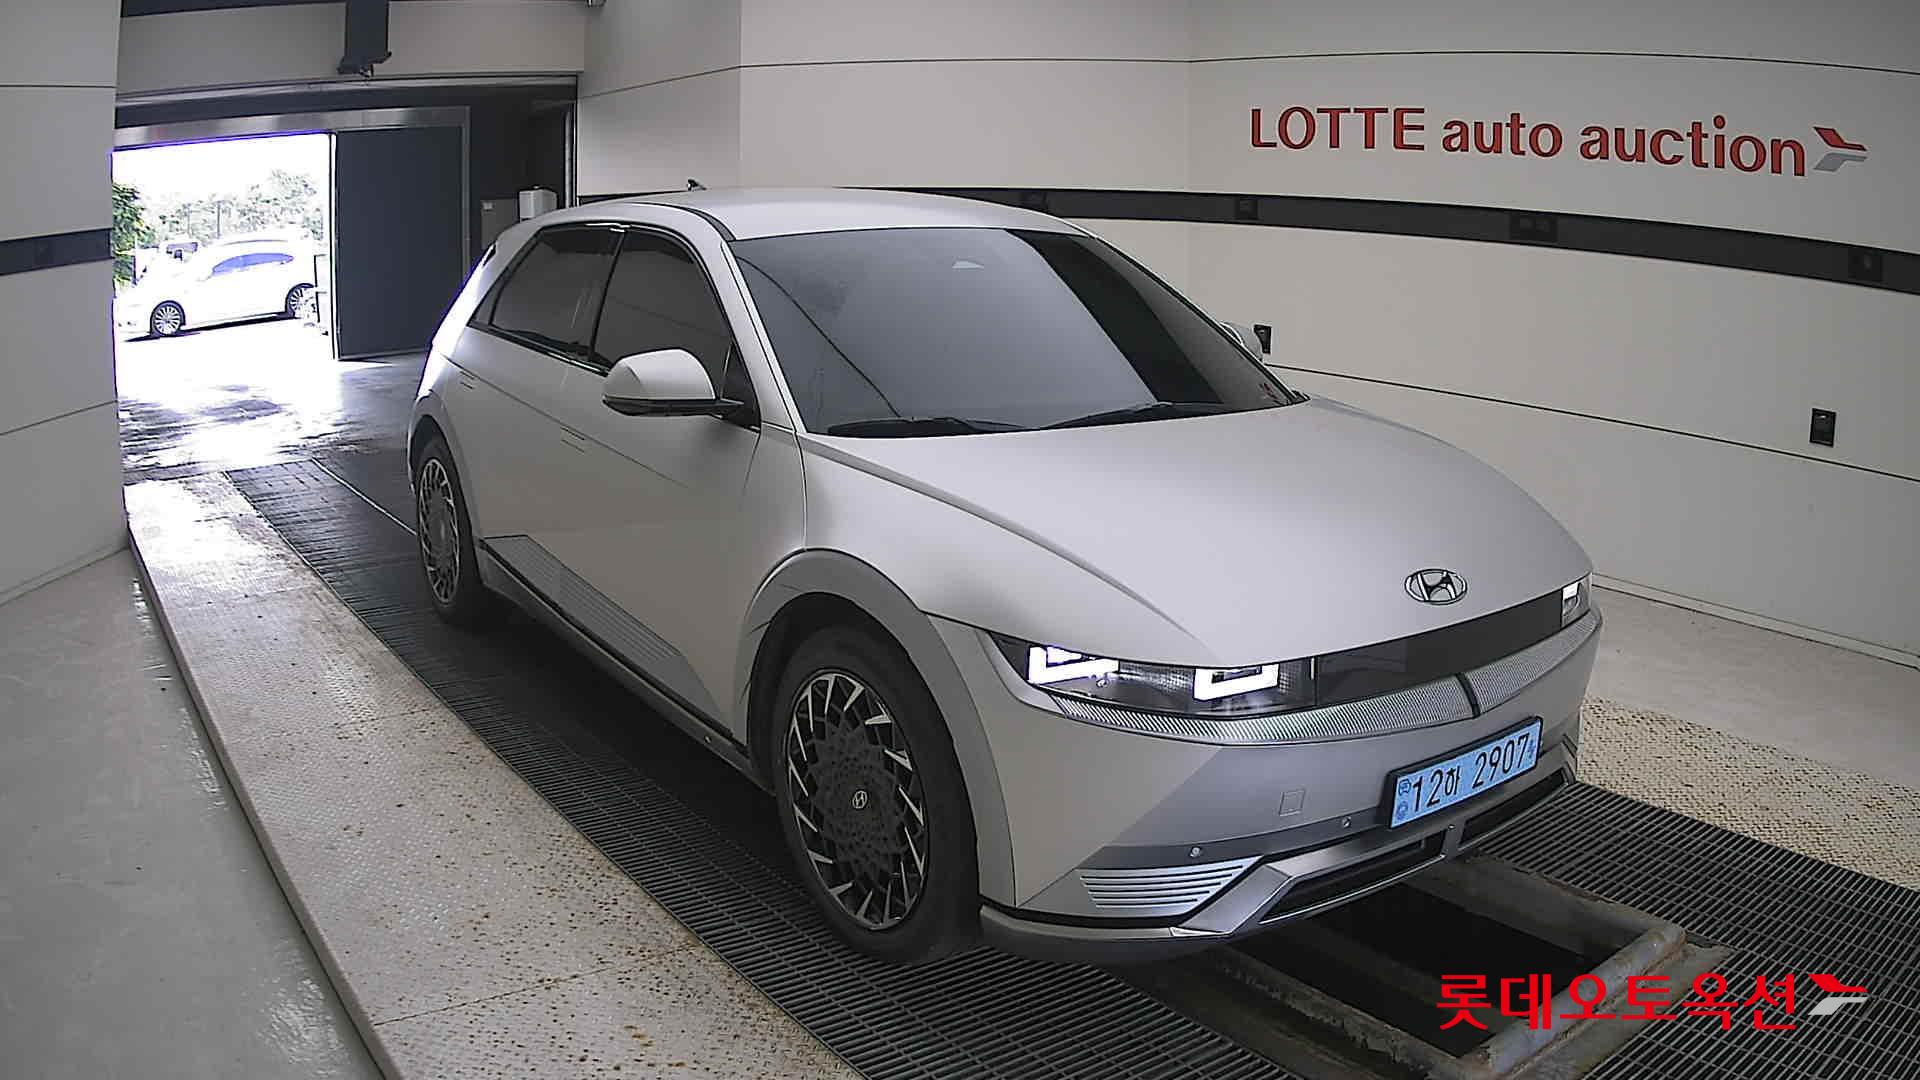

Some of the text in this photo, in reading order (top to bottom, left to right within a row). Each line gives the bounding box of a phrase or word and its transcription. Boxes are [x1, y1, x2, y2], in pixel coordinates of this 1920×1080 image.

[1250, 106, 1806, 177] LOTTE auto auction
[1412, 733, 1530, 812] 12하 2907
